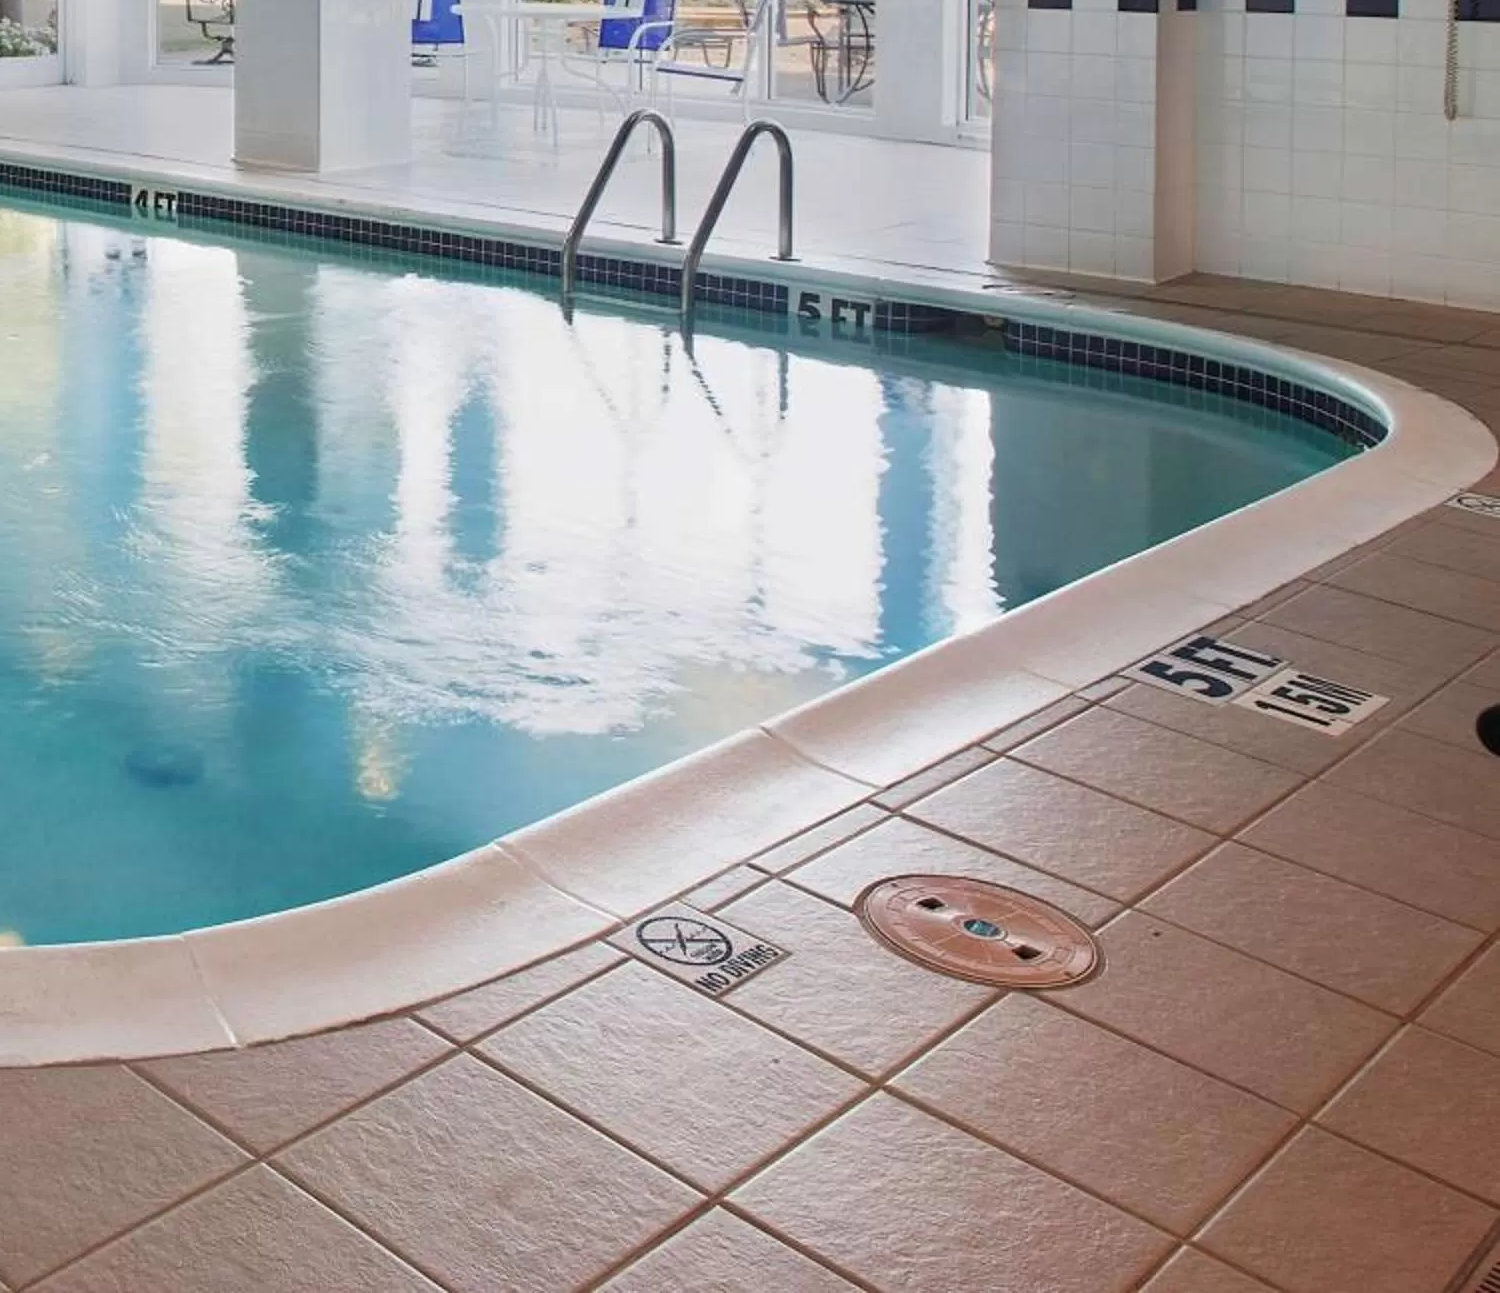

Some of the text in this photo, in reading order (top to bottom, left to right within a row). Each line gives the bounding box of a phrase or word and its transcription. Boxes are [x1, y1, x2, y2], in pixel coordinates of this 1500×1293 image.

[798, 291, 871, 326] 5 FT
[695, 972, 731, 992] NO
[721, 944, 779, 978] DIVING
